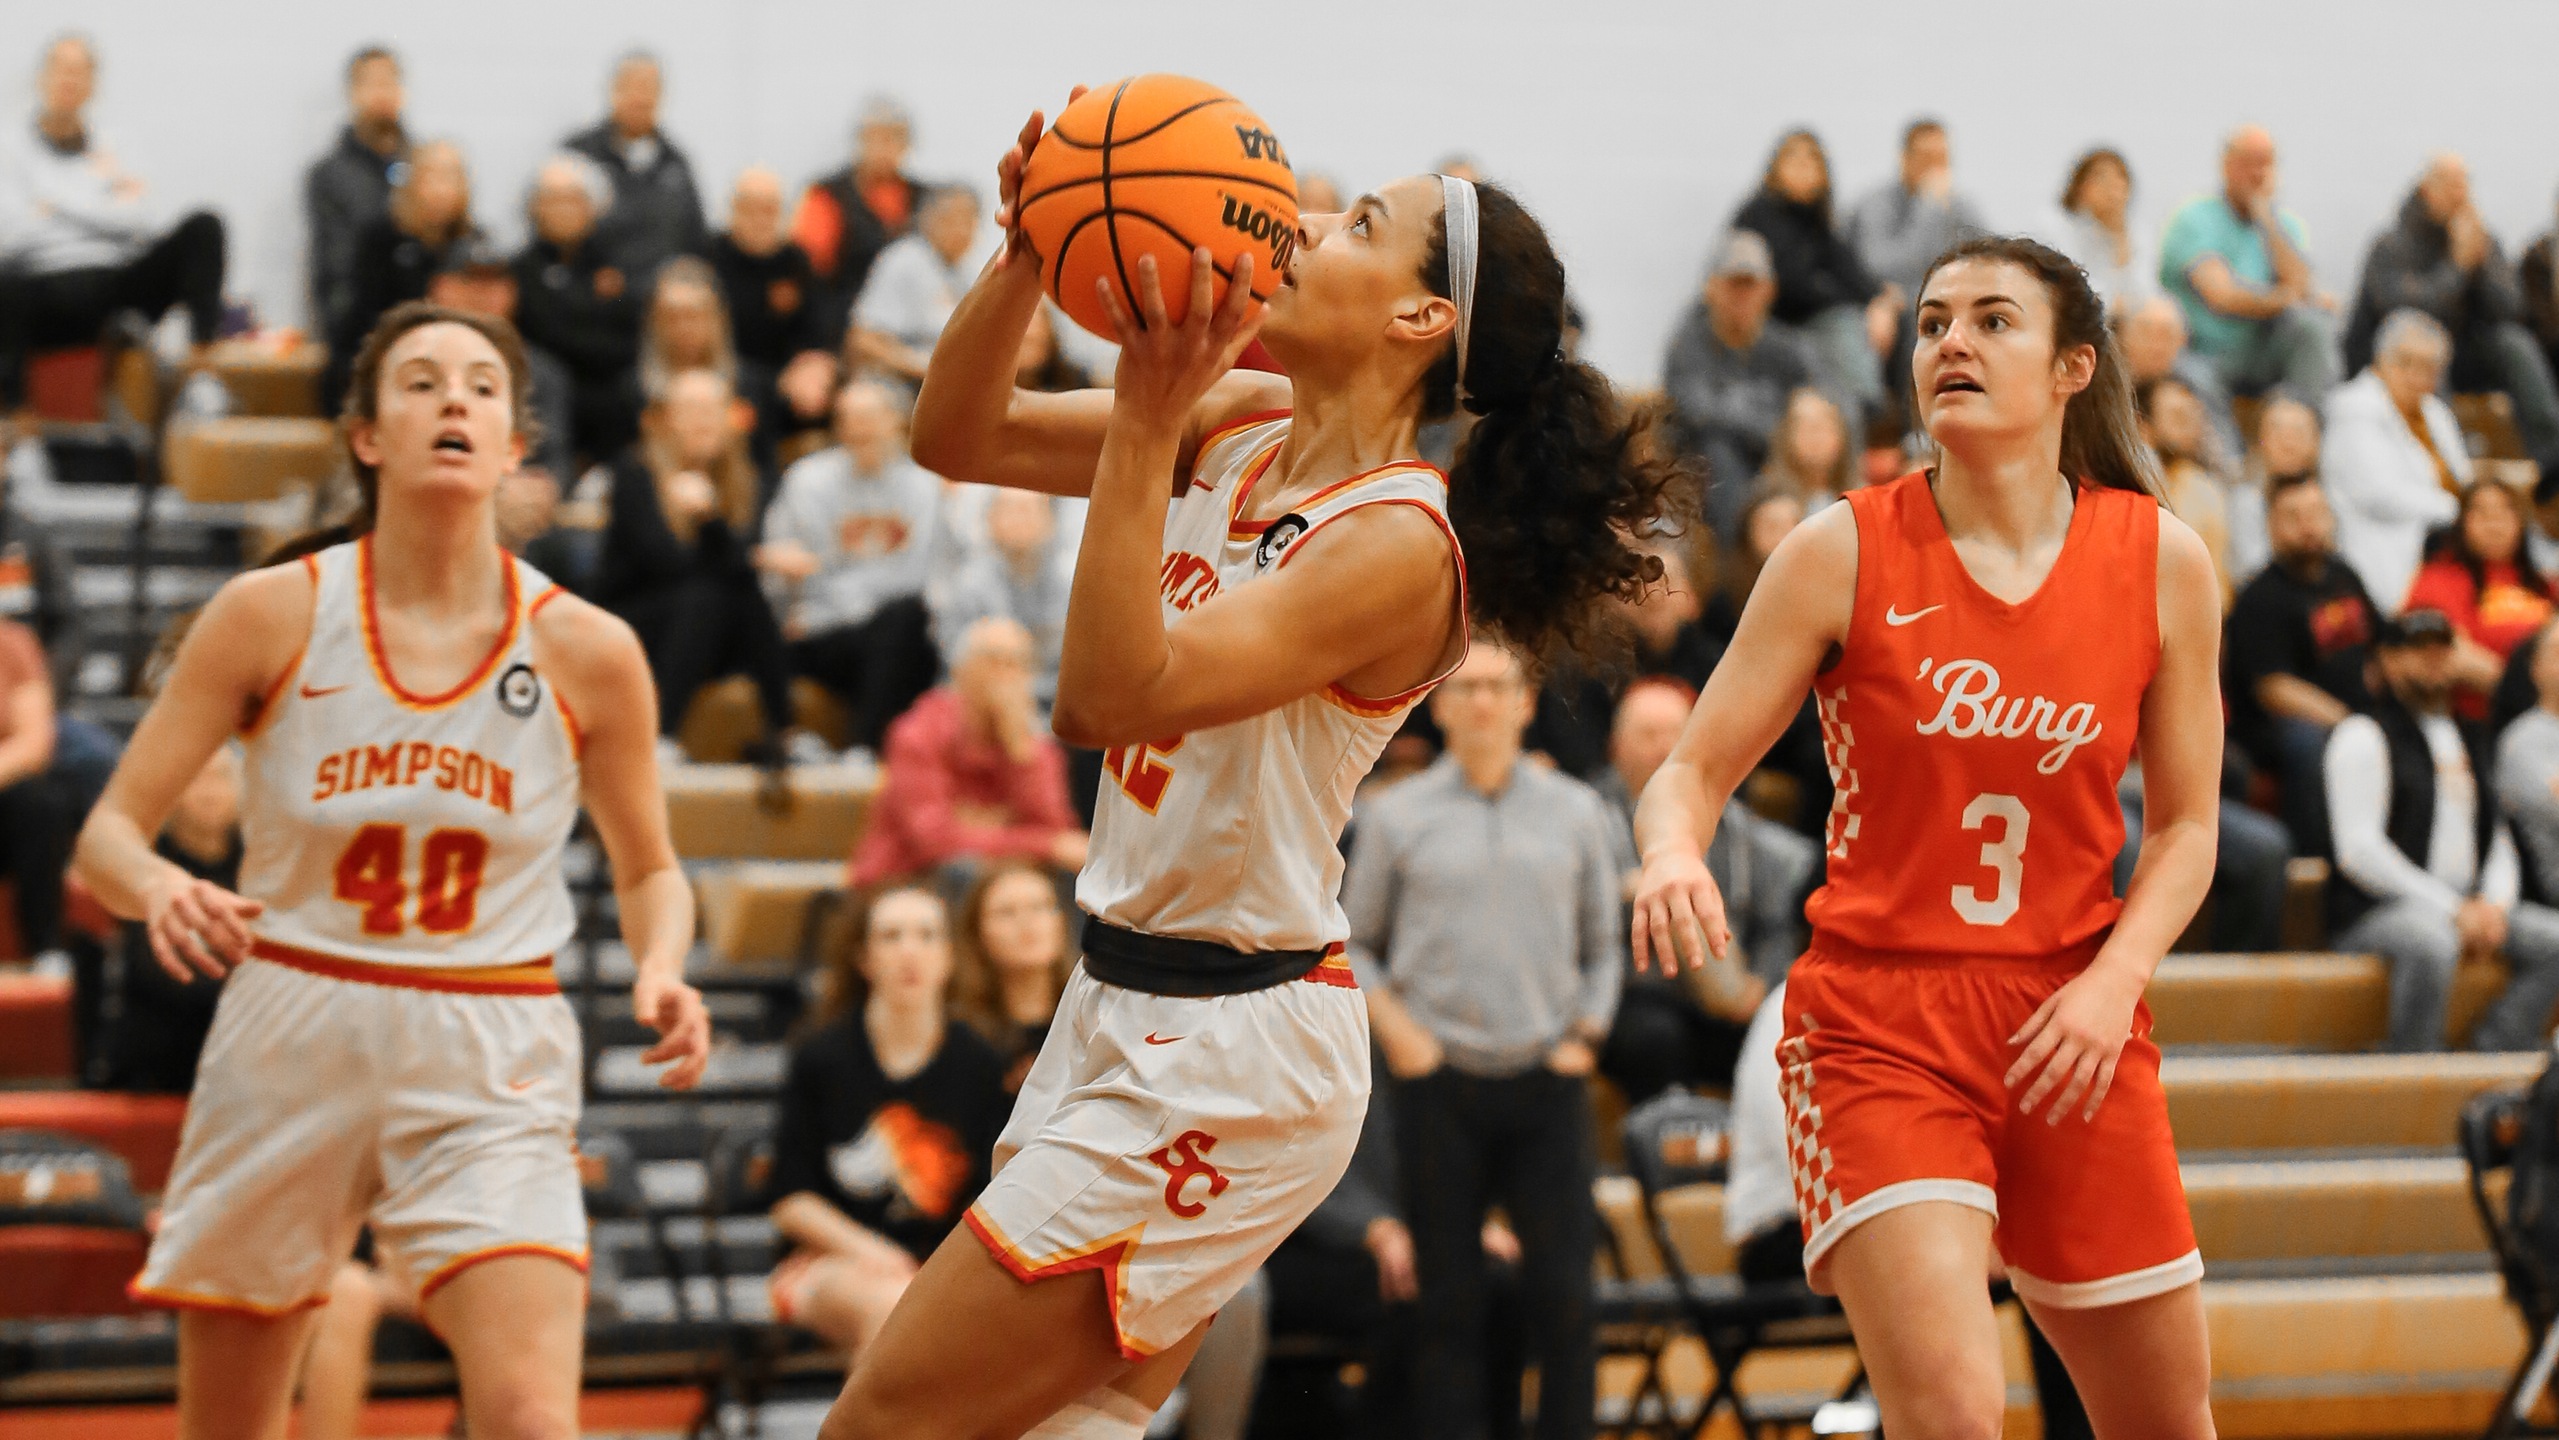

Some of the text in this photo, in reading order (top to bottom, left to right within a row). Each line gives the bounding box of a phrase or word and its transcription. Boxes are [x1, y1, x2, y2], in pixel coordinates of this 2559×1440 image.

[1914, 656, 2102, 775] 'Burg
[311, 741, 513, 815] SIMPSON
[333, 820, 488, 936] 40
[1951, 792, 2031, 926] 3
[1147, 1129, 1231, 1220] SC
